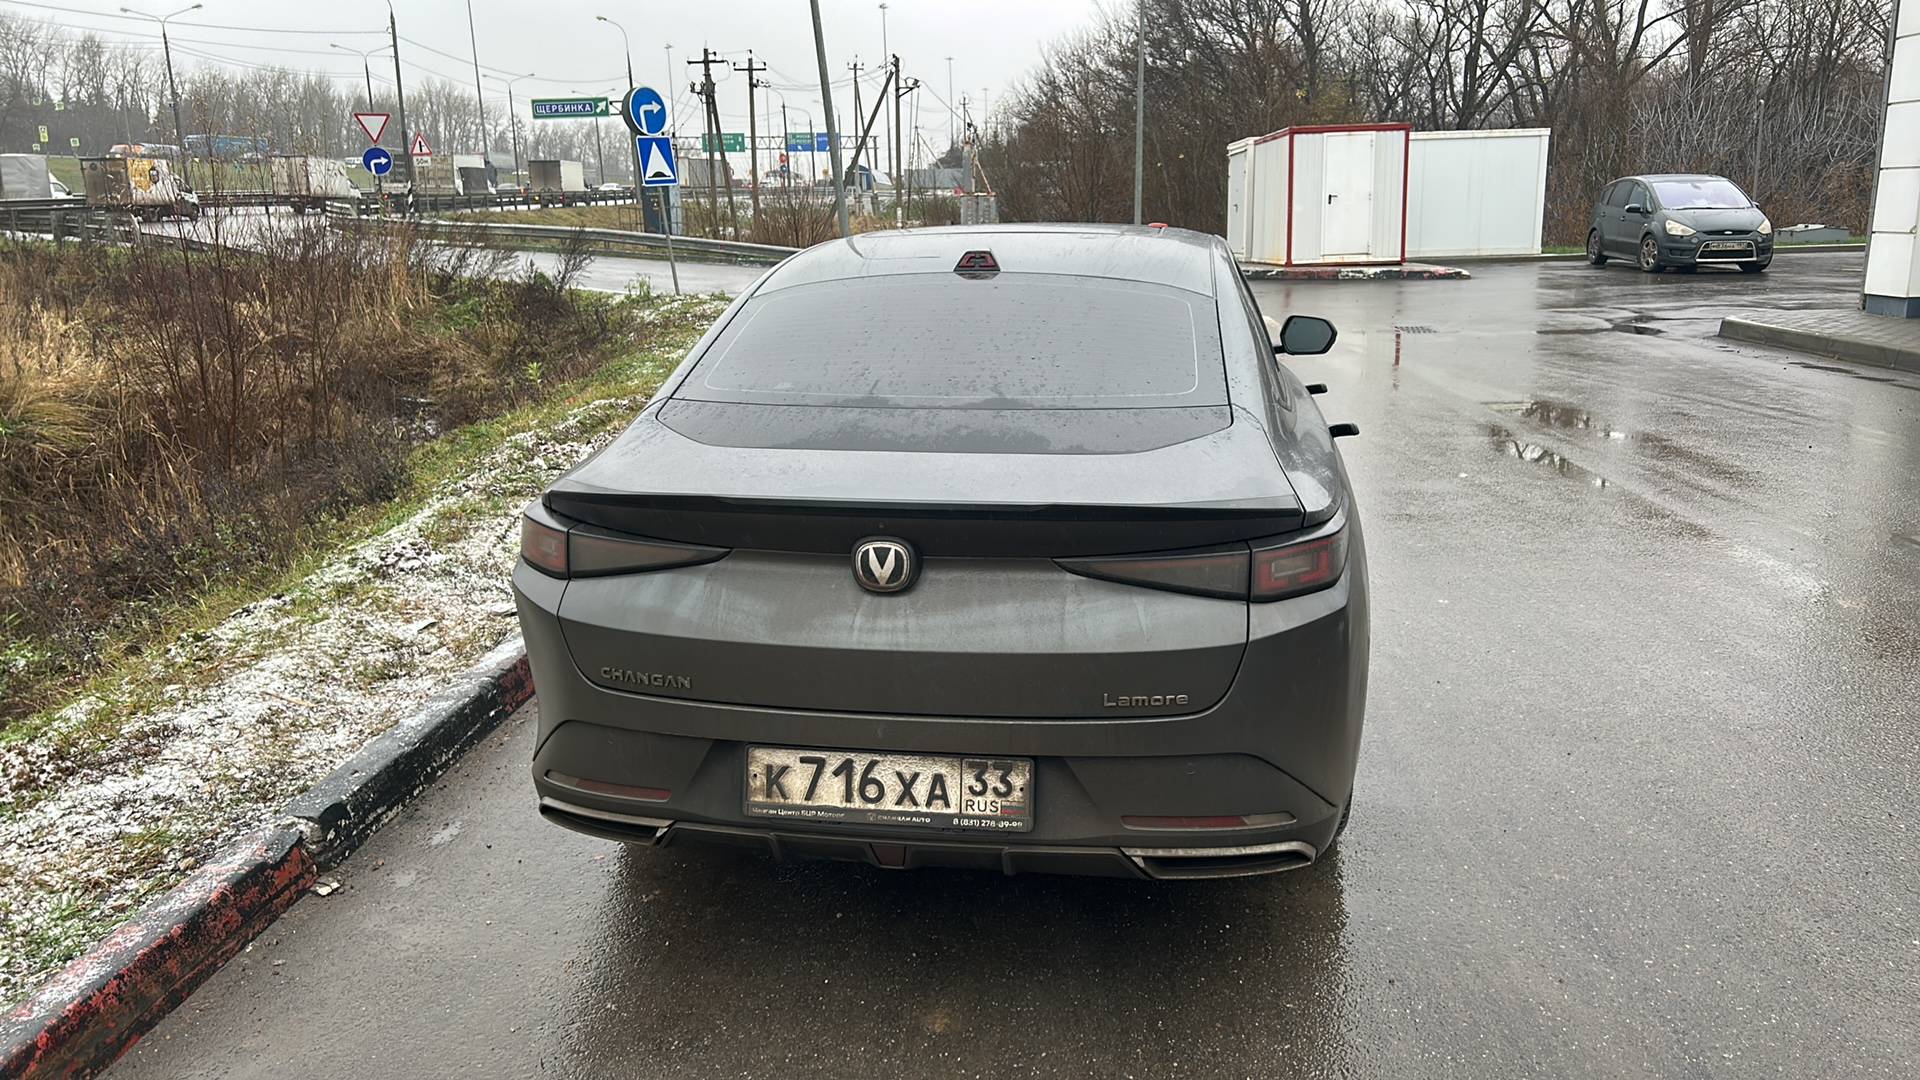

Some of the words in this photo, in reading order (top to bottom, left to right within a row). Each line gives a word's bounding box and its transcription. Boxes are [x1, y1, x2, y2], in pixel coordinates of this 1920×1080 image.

[536, 103, 592, 114] ЩЕРБИНКА
[600, 666, 692, 689] CHANGAN
[1103, 693, 1189, 707] Lamore
[966, 760, 1014, 798] 33
[965, 799, 999, 813] RUS
